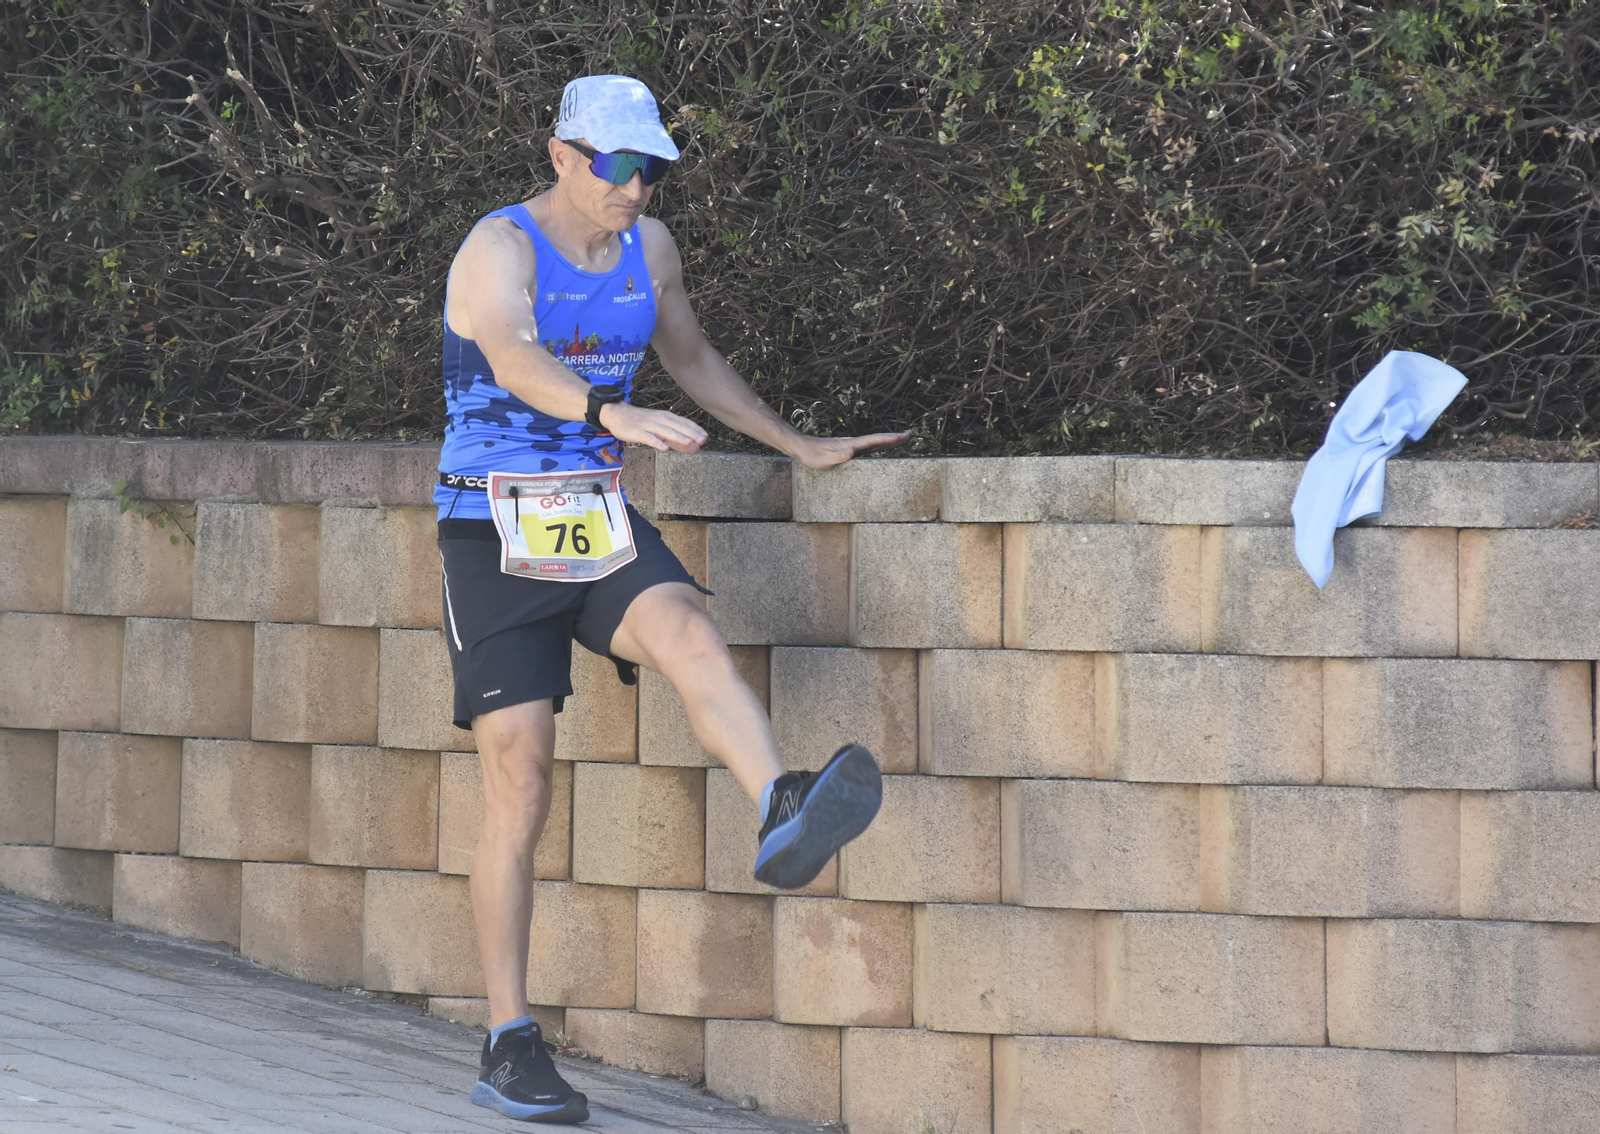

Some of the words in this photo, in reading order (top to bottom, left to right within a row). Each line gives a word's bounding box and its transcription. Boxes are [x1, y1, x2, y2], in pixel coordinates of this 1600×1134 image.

[540, 494, 567, 509] GO
[567, 495, 581, 506] fit
[545, 523, 591, 555] 76
